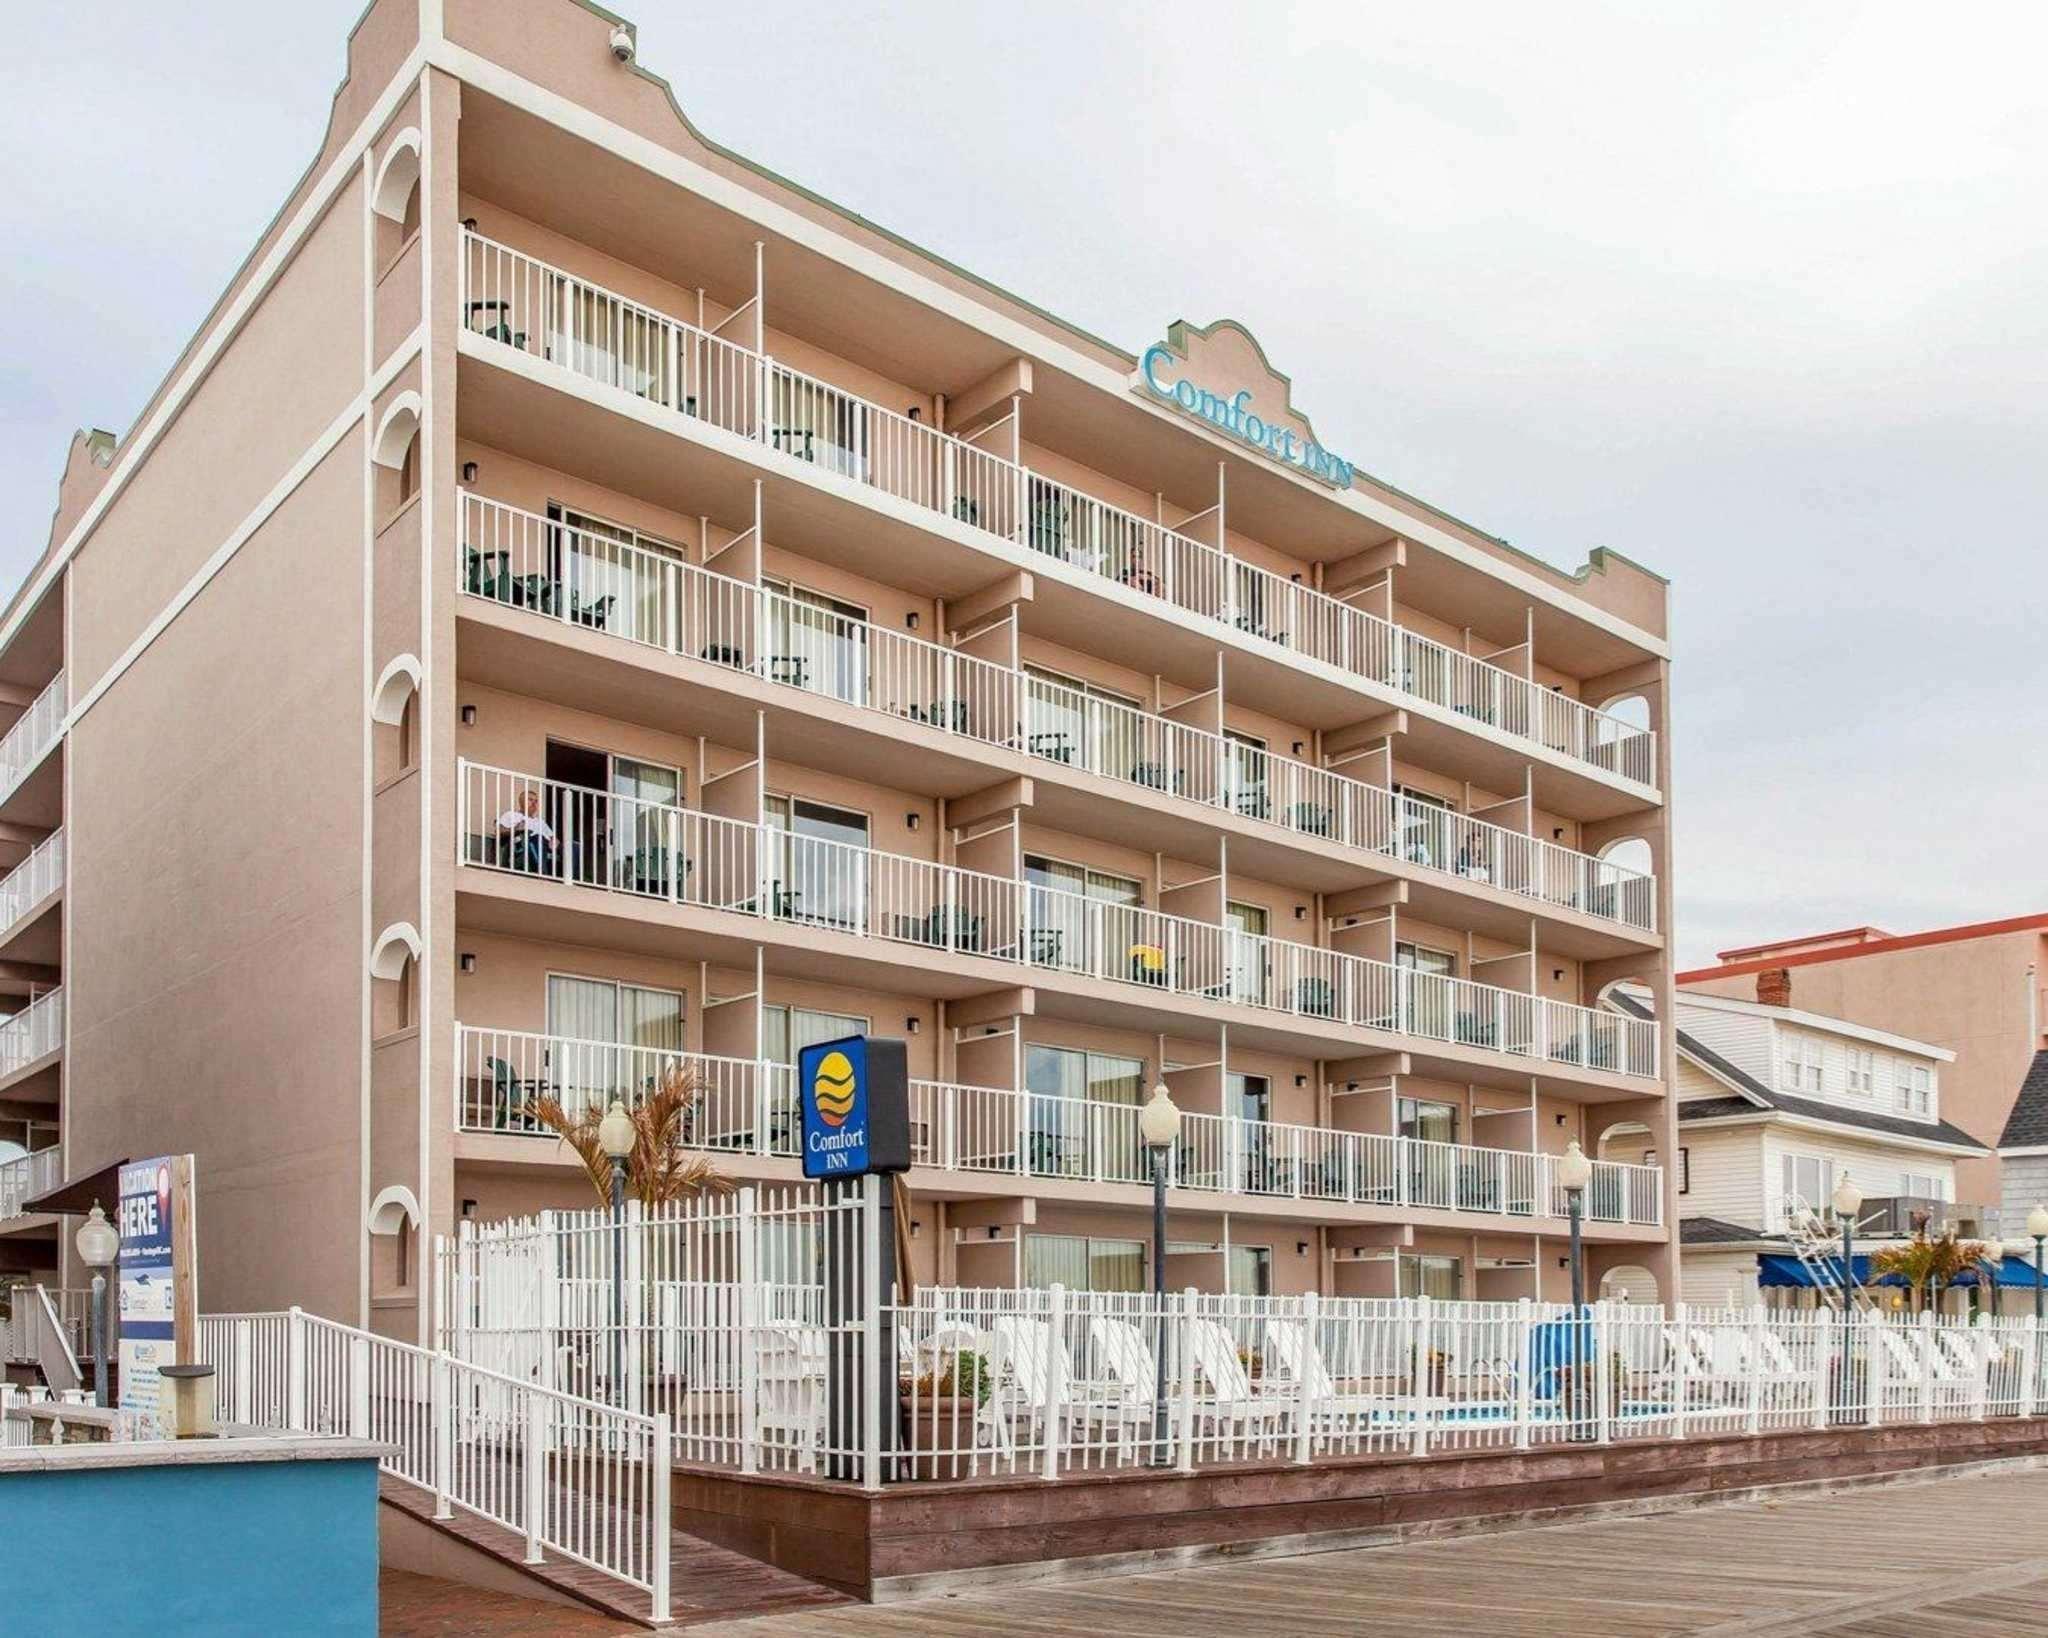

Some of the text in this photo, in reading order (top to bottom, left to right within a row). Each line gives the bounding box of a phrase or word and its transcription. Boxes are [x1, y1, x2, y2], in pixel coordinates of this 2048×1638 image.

[1141, 344, 1355, 490] Comfort INN
[809, 1126, 864, 1152] Comfort
[827, 1153, 848, 1169] INN
[119, 1195, 158, 1238] HERE
